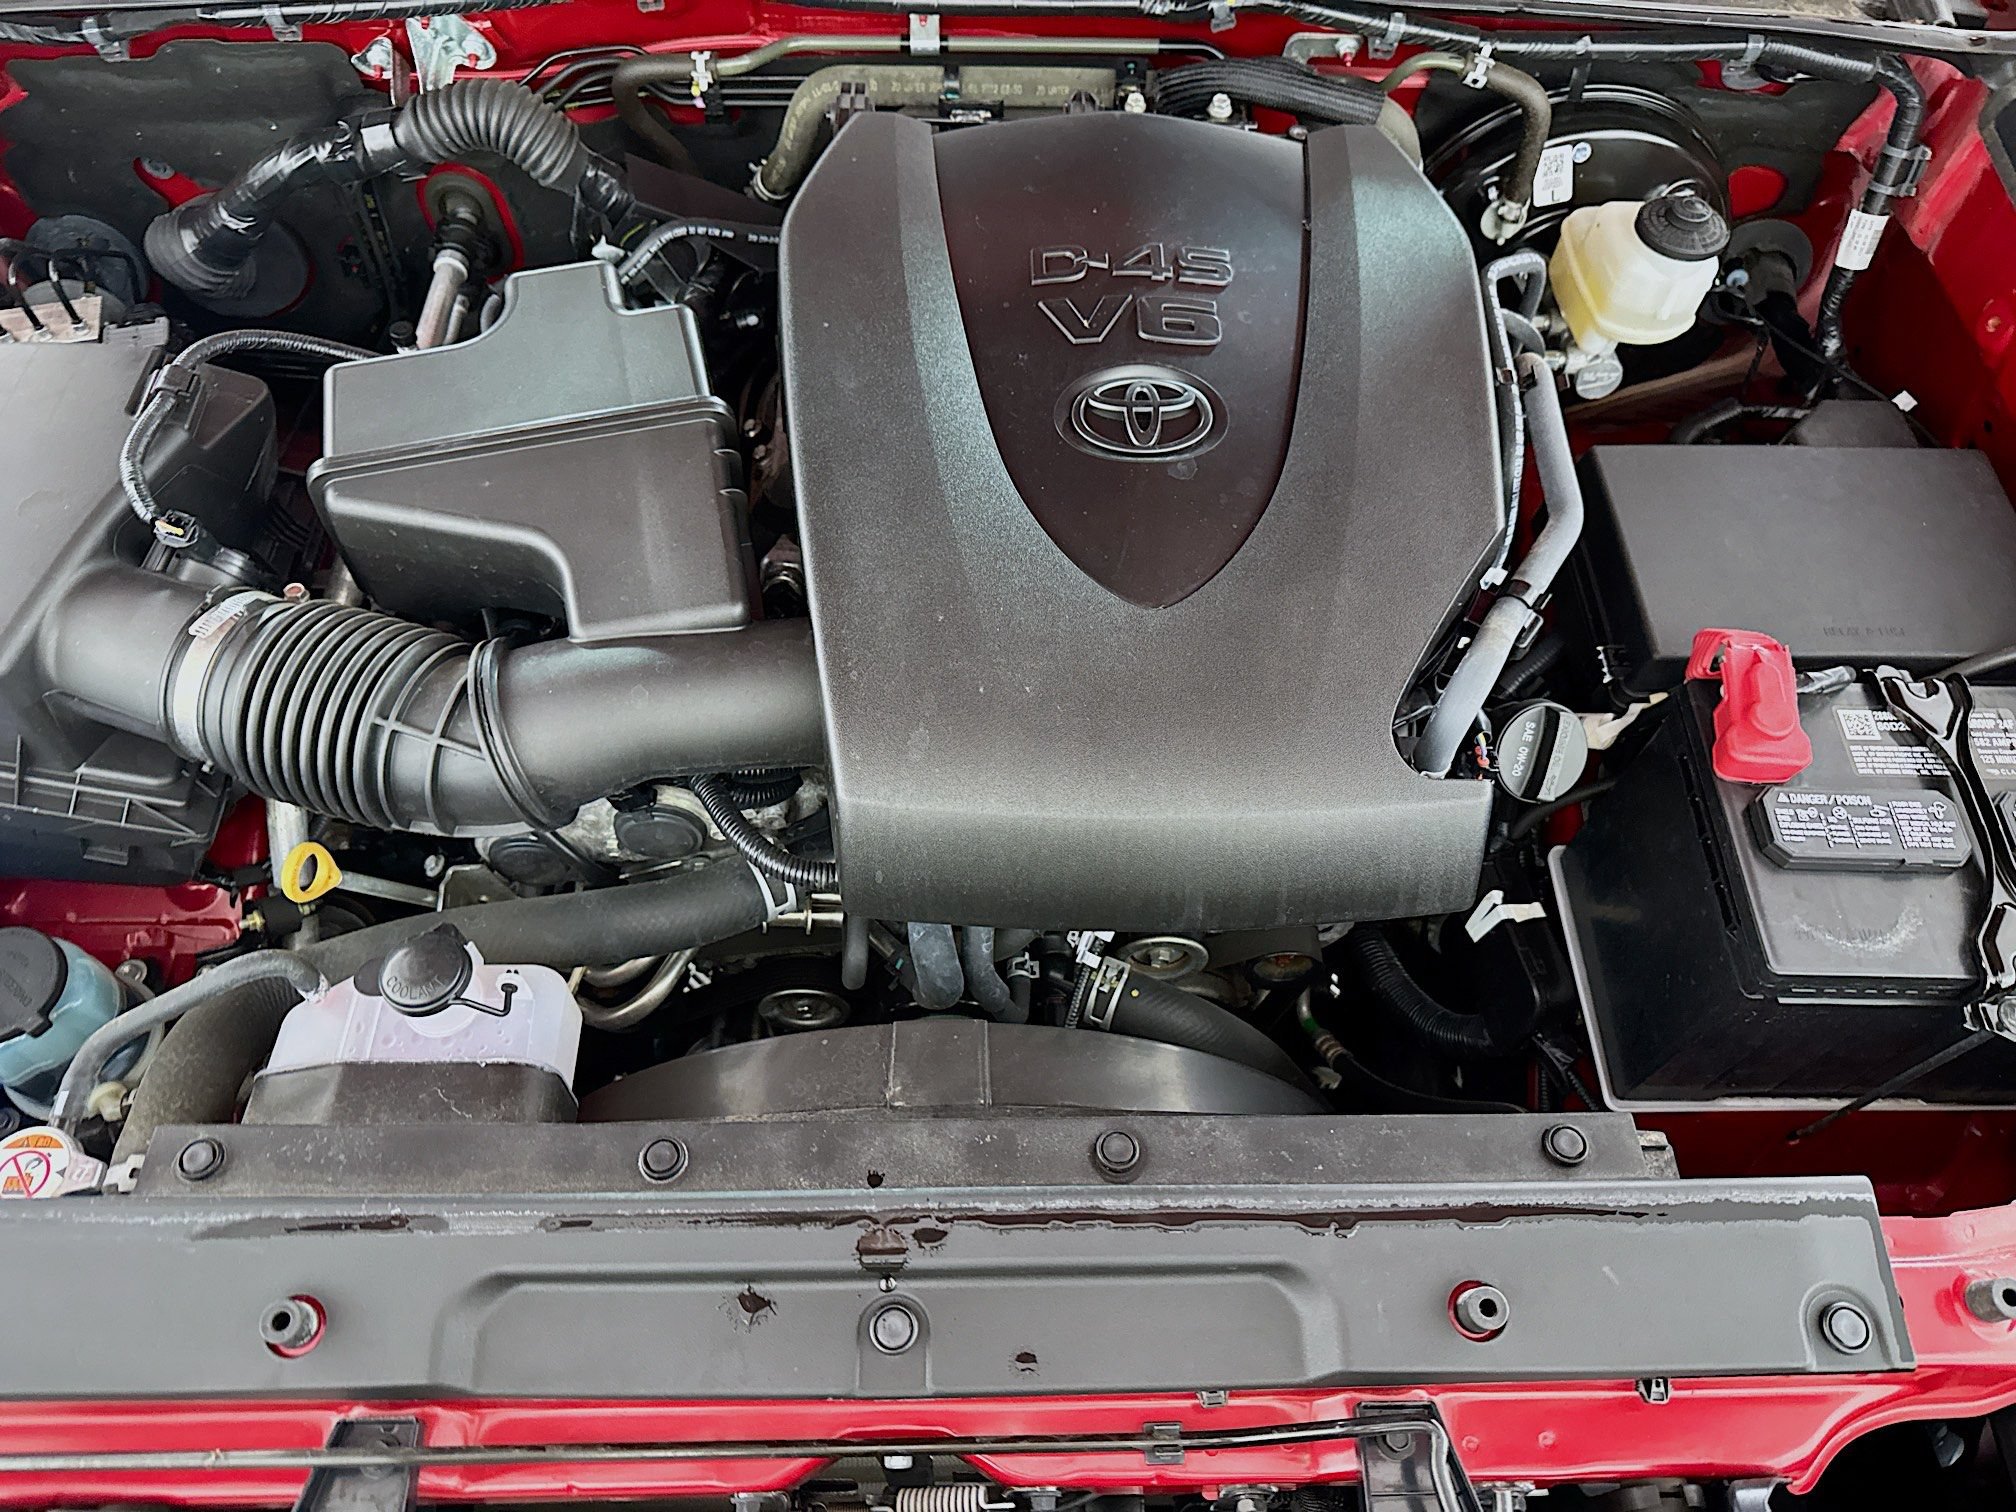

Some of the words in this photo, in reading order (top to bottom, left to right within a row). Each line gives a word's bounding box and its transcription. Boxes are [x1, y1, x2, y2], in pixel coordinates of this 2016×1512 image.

[1030, 242, 1234, 287] D-4S
[1037, 293, 1223, 346] V6
[1522, 721, 1536, 742] SAE
[1511, 746, 1529, 777] 0W-20
[1789, 793, 1829, 804] DANGER
[1836, 795, 1872, 806] POISON
[387, 975, 445, 999] COOLANT
